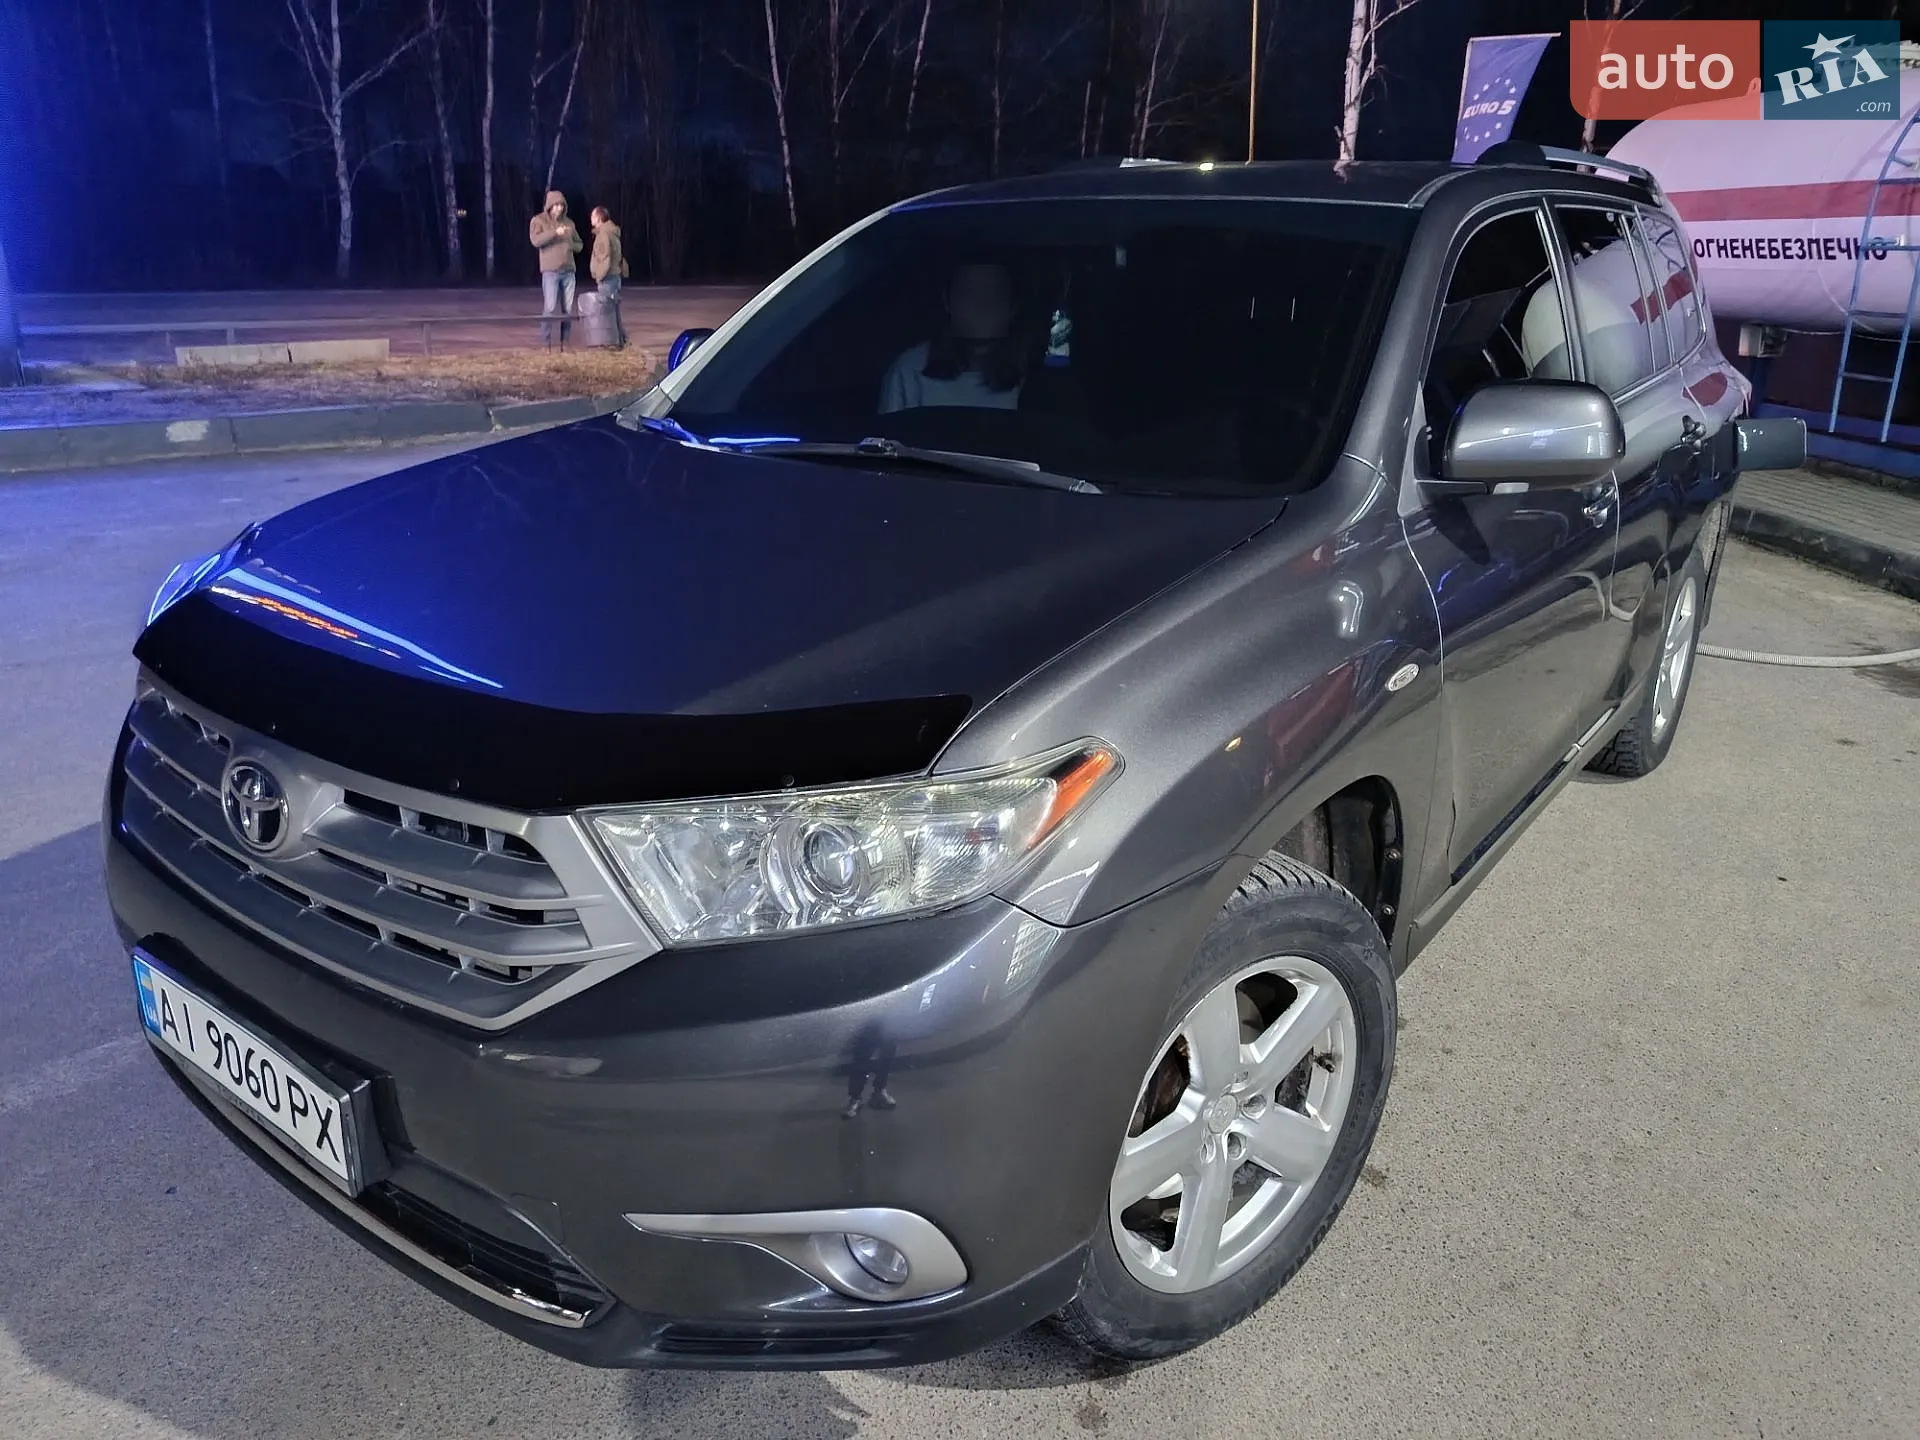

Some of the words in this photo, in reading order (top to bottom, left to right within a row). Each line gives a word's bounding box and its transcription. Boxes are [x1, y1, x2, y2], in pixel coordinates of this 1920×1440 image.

[1693, 236, 1887, 261] ОГНЕНЕБЕЗПЕЧНО
[205, 1019, 281, 1113] 9060
[285, 1074, 341, 1163] PX
